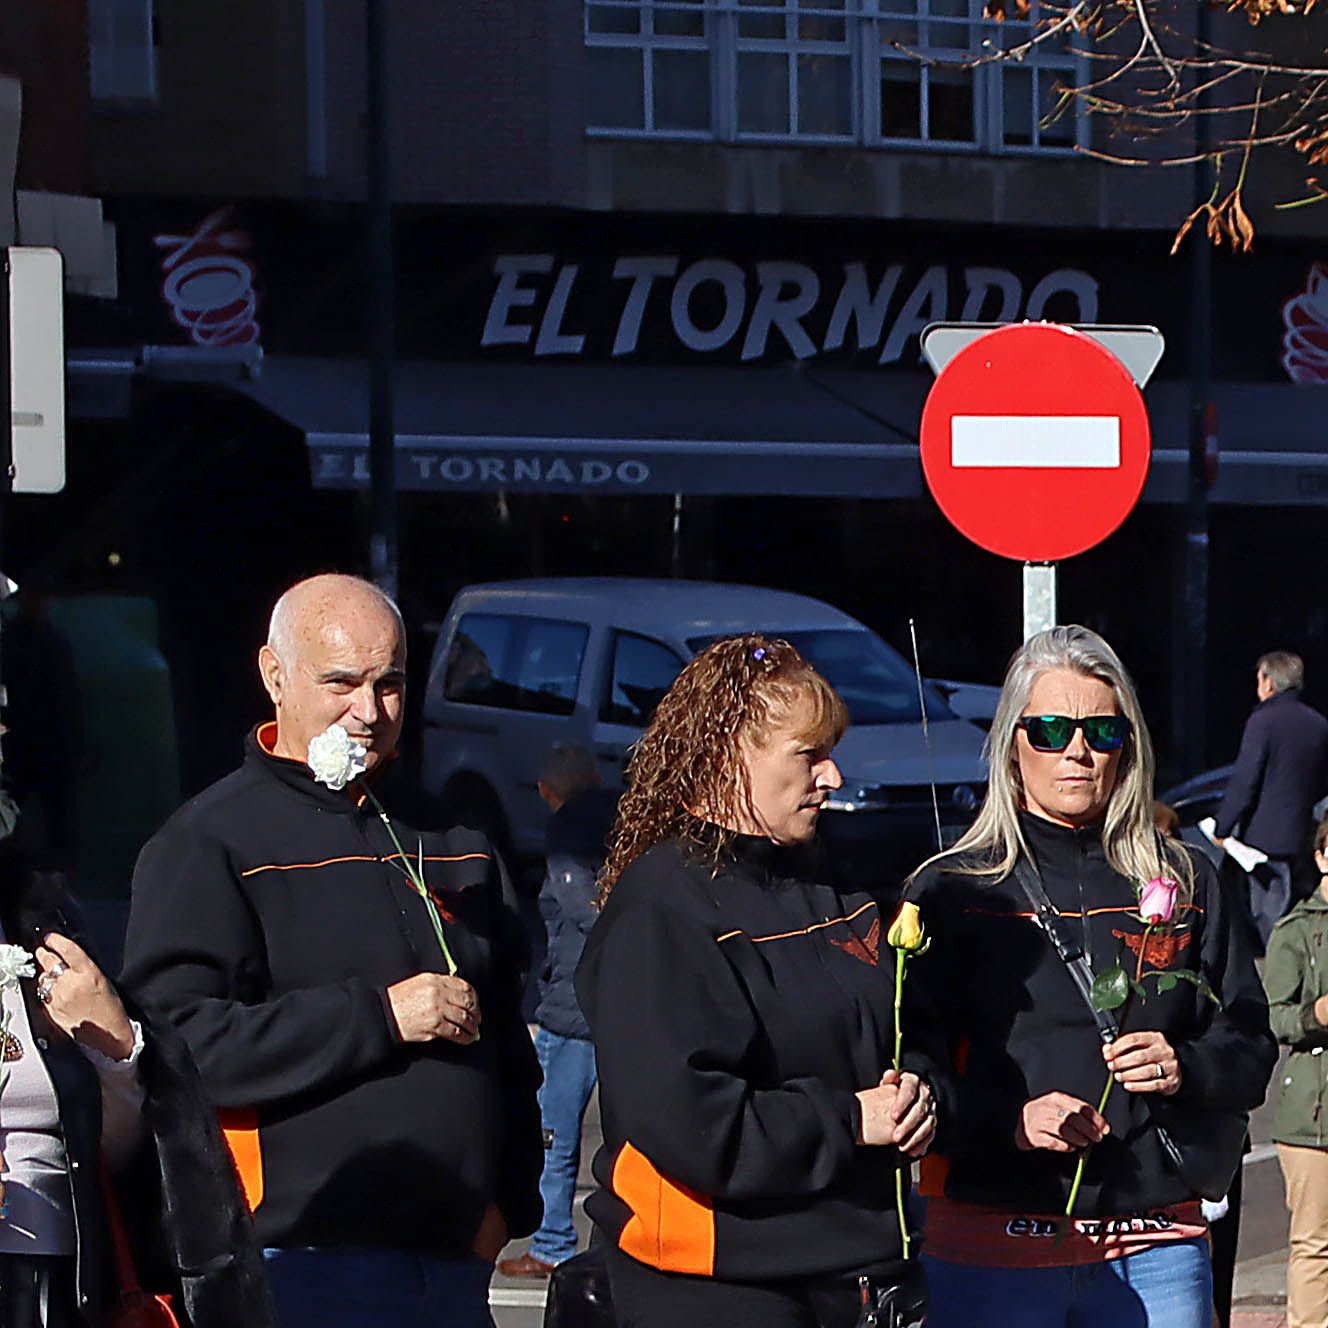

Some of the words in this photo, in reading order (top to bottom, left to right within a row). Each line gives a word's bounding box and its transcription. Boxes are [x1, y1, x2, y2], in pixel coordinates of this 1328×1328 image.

[480, 253, 587, 358] EL
[610, 255, 1100, 366] TORNADO
[316, 453, 372, 481] EL
[409, 455, 651, 484] TORNADO
